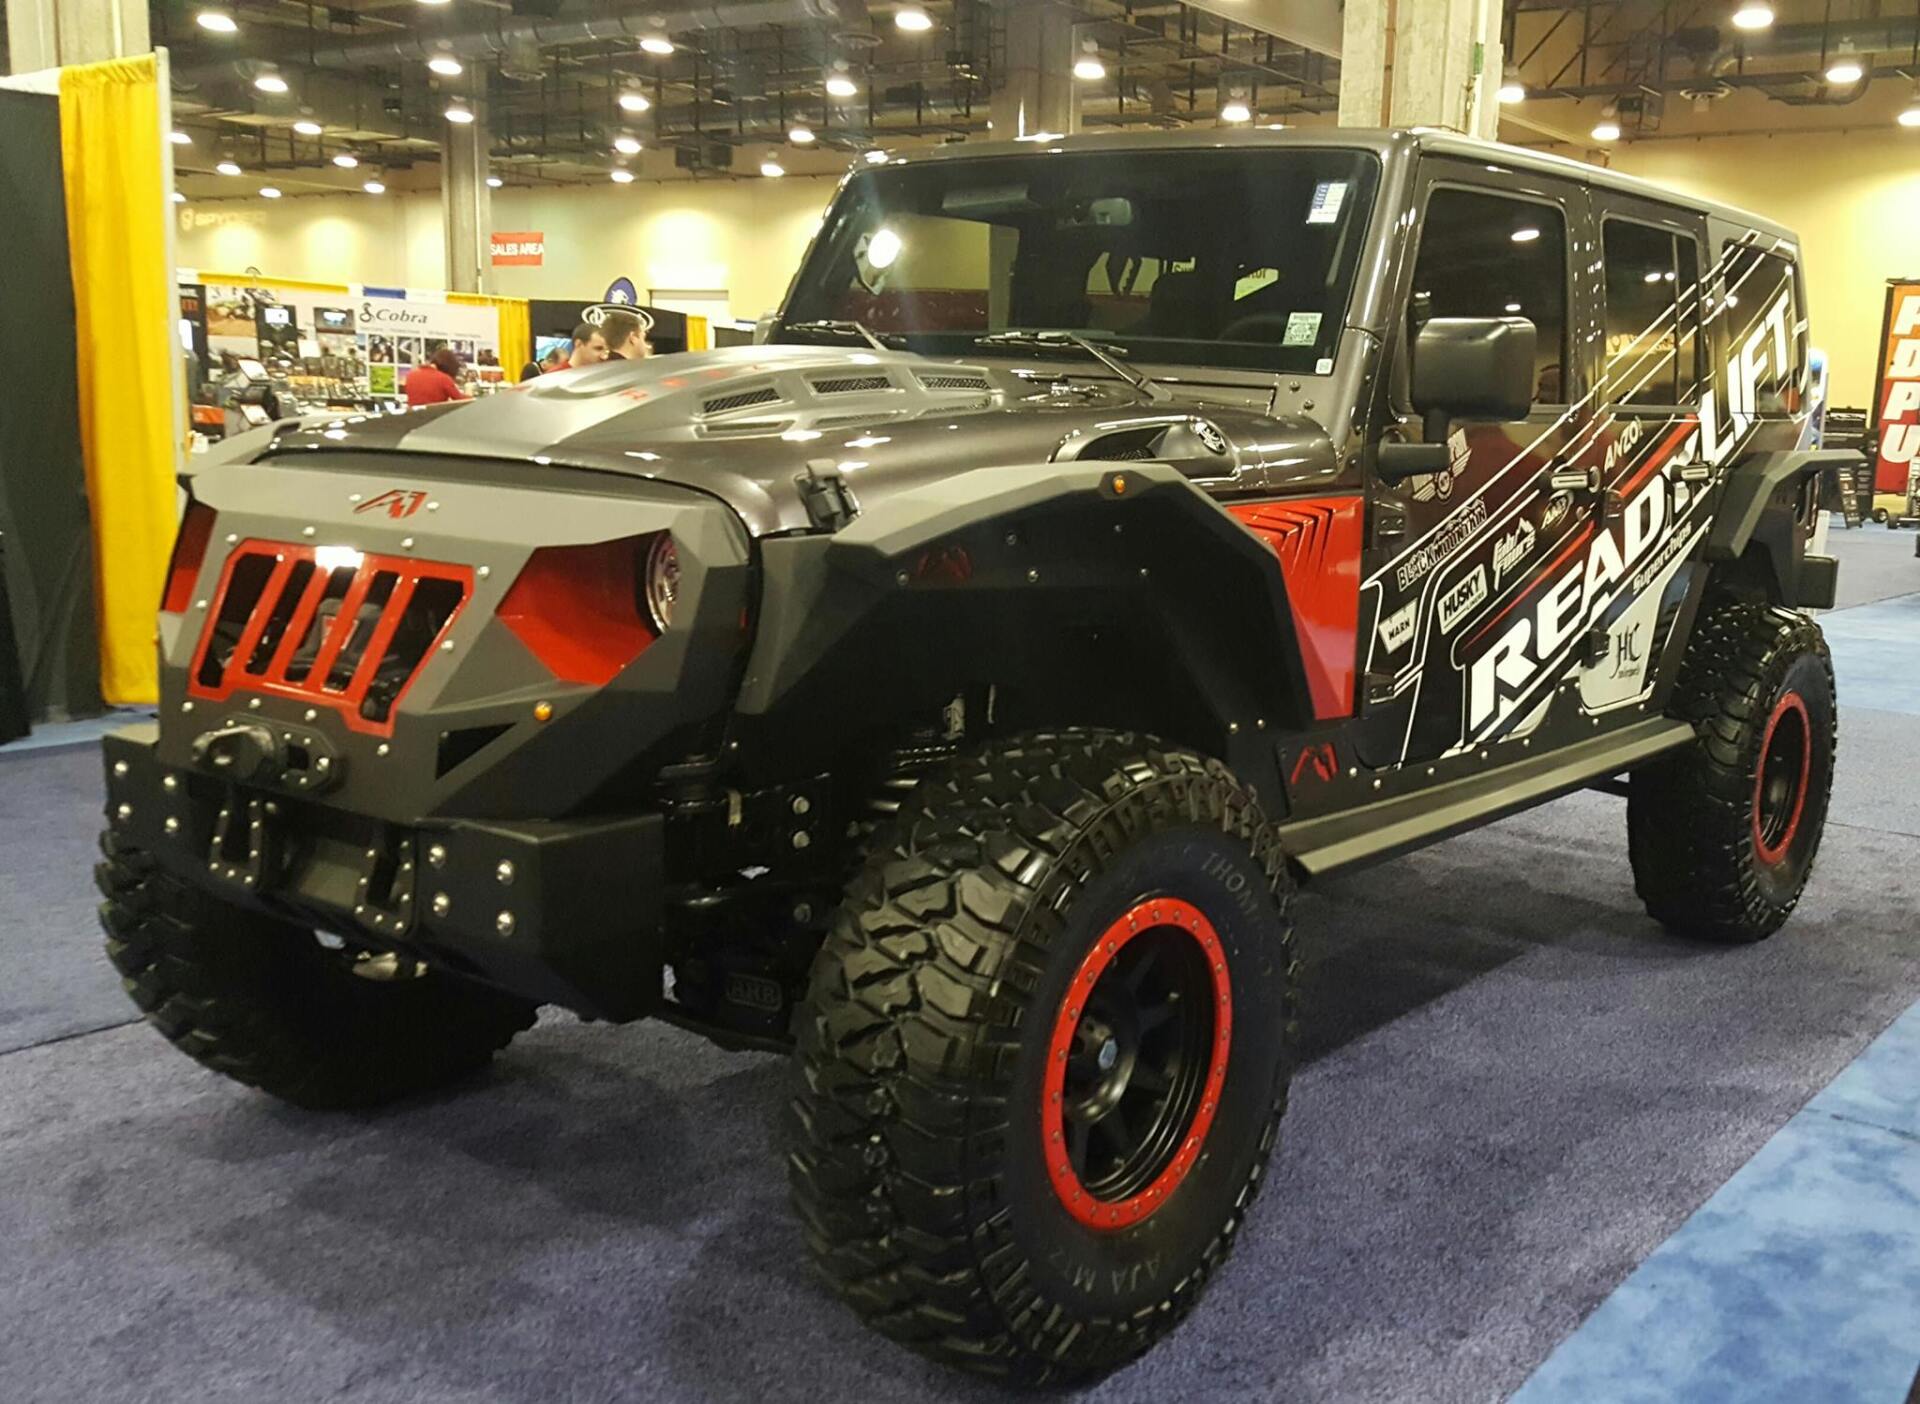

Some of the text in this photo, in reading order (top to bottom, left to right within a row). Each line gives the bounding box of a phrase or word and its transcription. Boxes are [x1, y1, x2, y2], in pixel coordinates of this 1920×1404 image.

[490, 243, 544, 256] SALES AREA
[376, 308, 428, 324] Cobra
[1443, 570, 1480, 621] HUSKY
[1388, 617, 1410, 640] WARN
